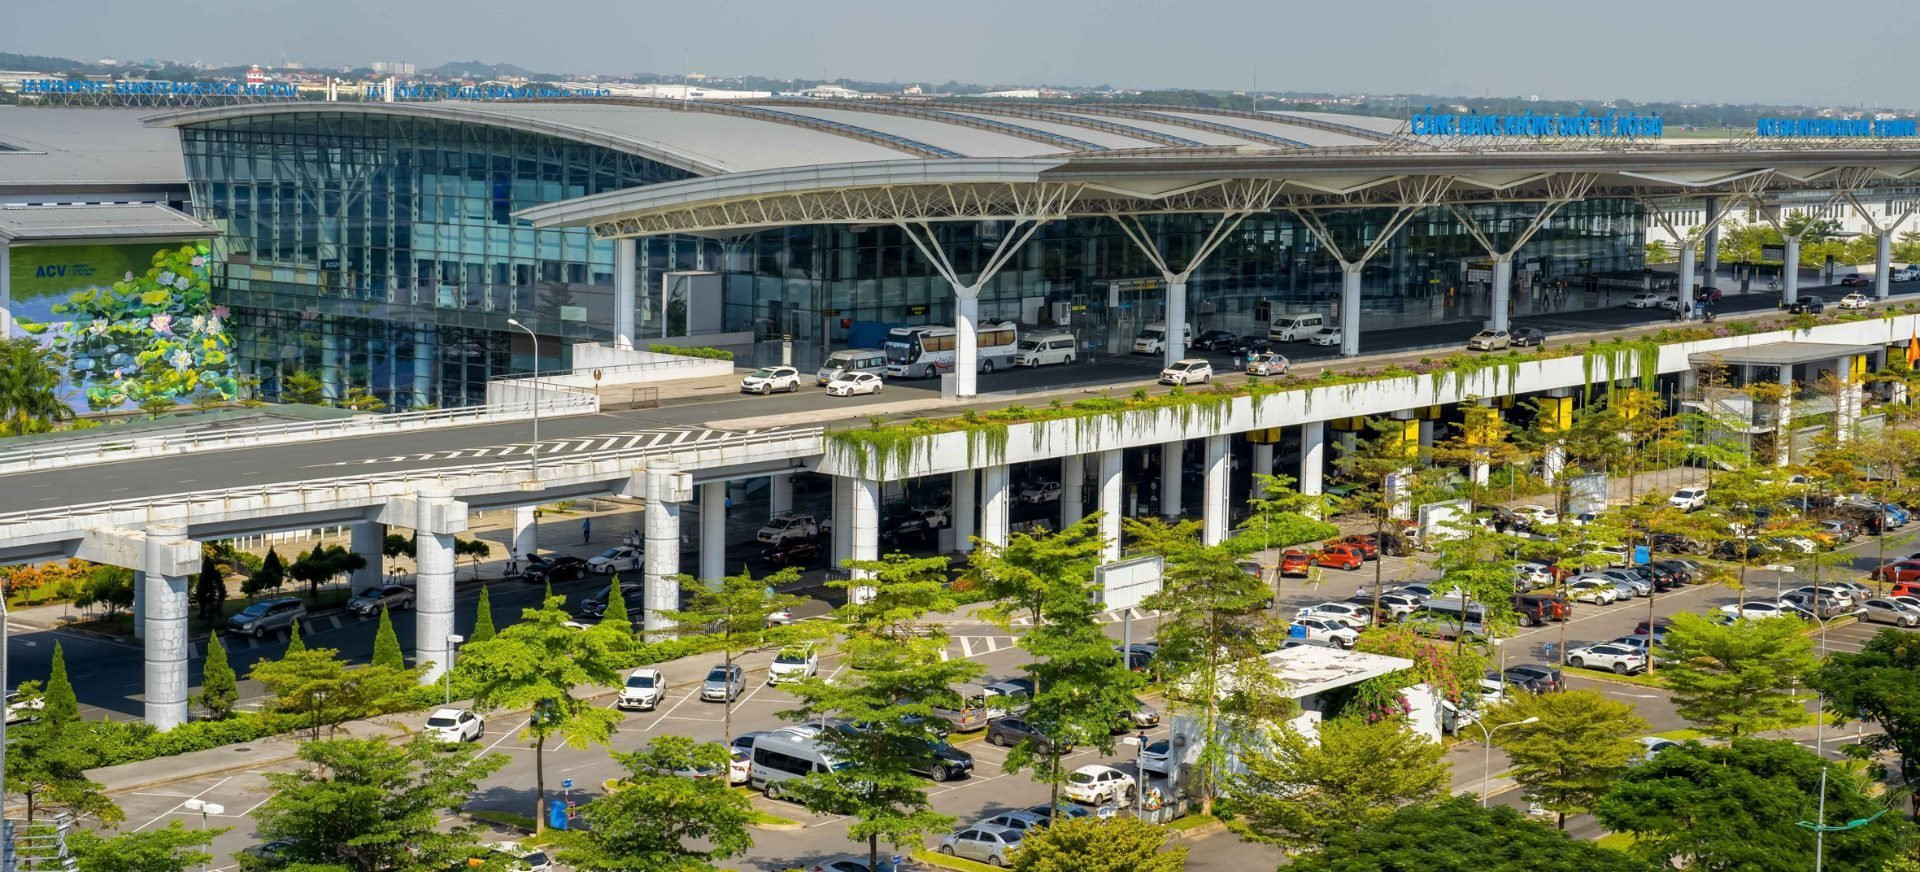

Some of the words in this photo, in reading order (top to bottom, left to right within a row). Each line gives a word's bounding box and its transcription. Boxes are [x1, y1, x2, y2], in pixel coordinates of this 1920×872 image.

[1411, 104, 1456, 136] CẢNG
[1460, 108, 1500, 136] HÀNG
[1505, 108, 1554, 137] KHÔNG
[1557, 106, 1596, 137] QUỐC
[36, 264, 67, 278] ACV
